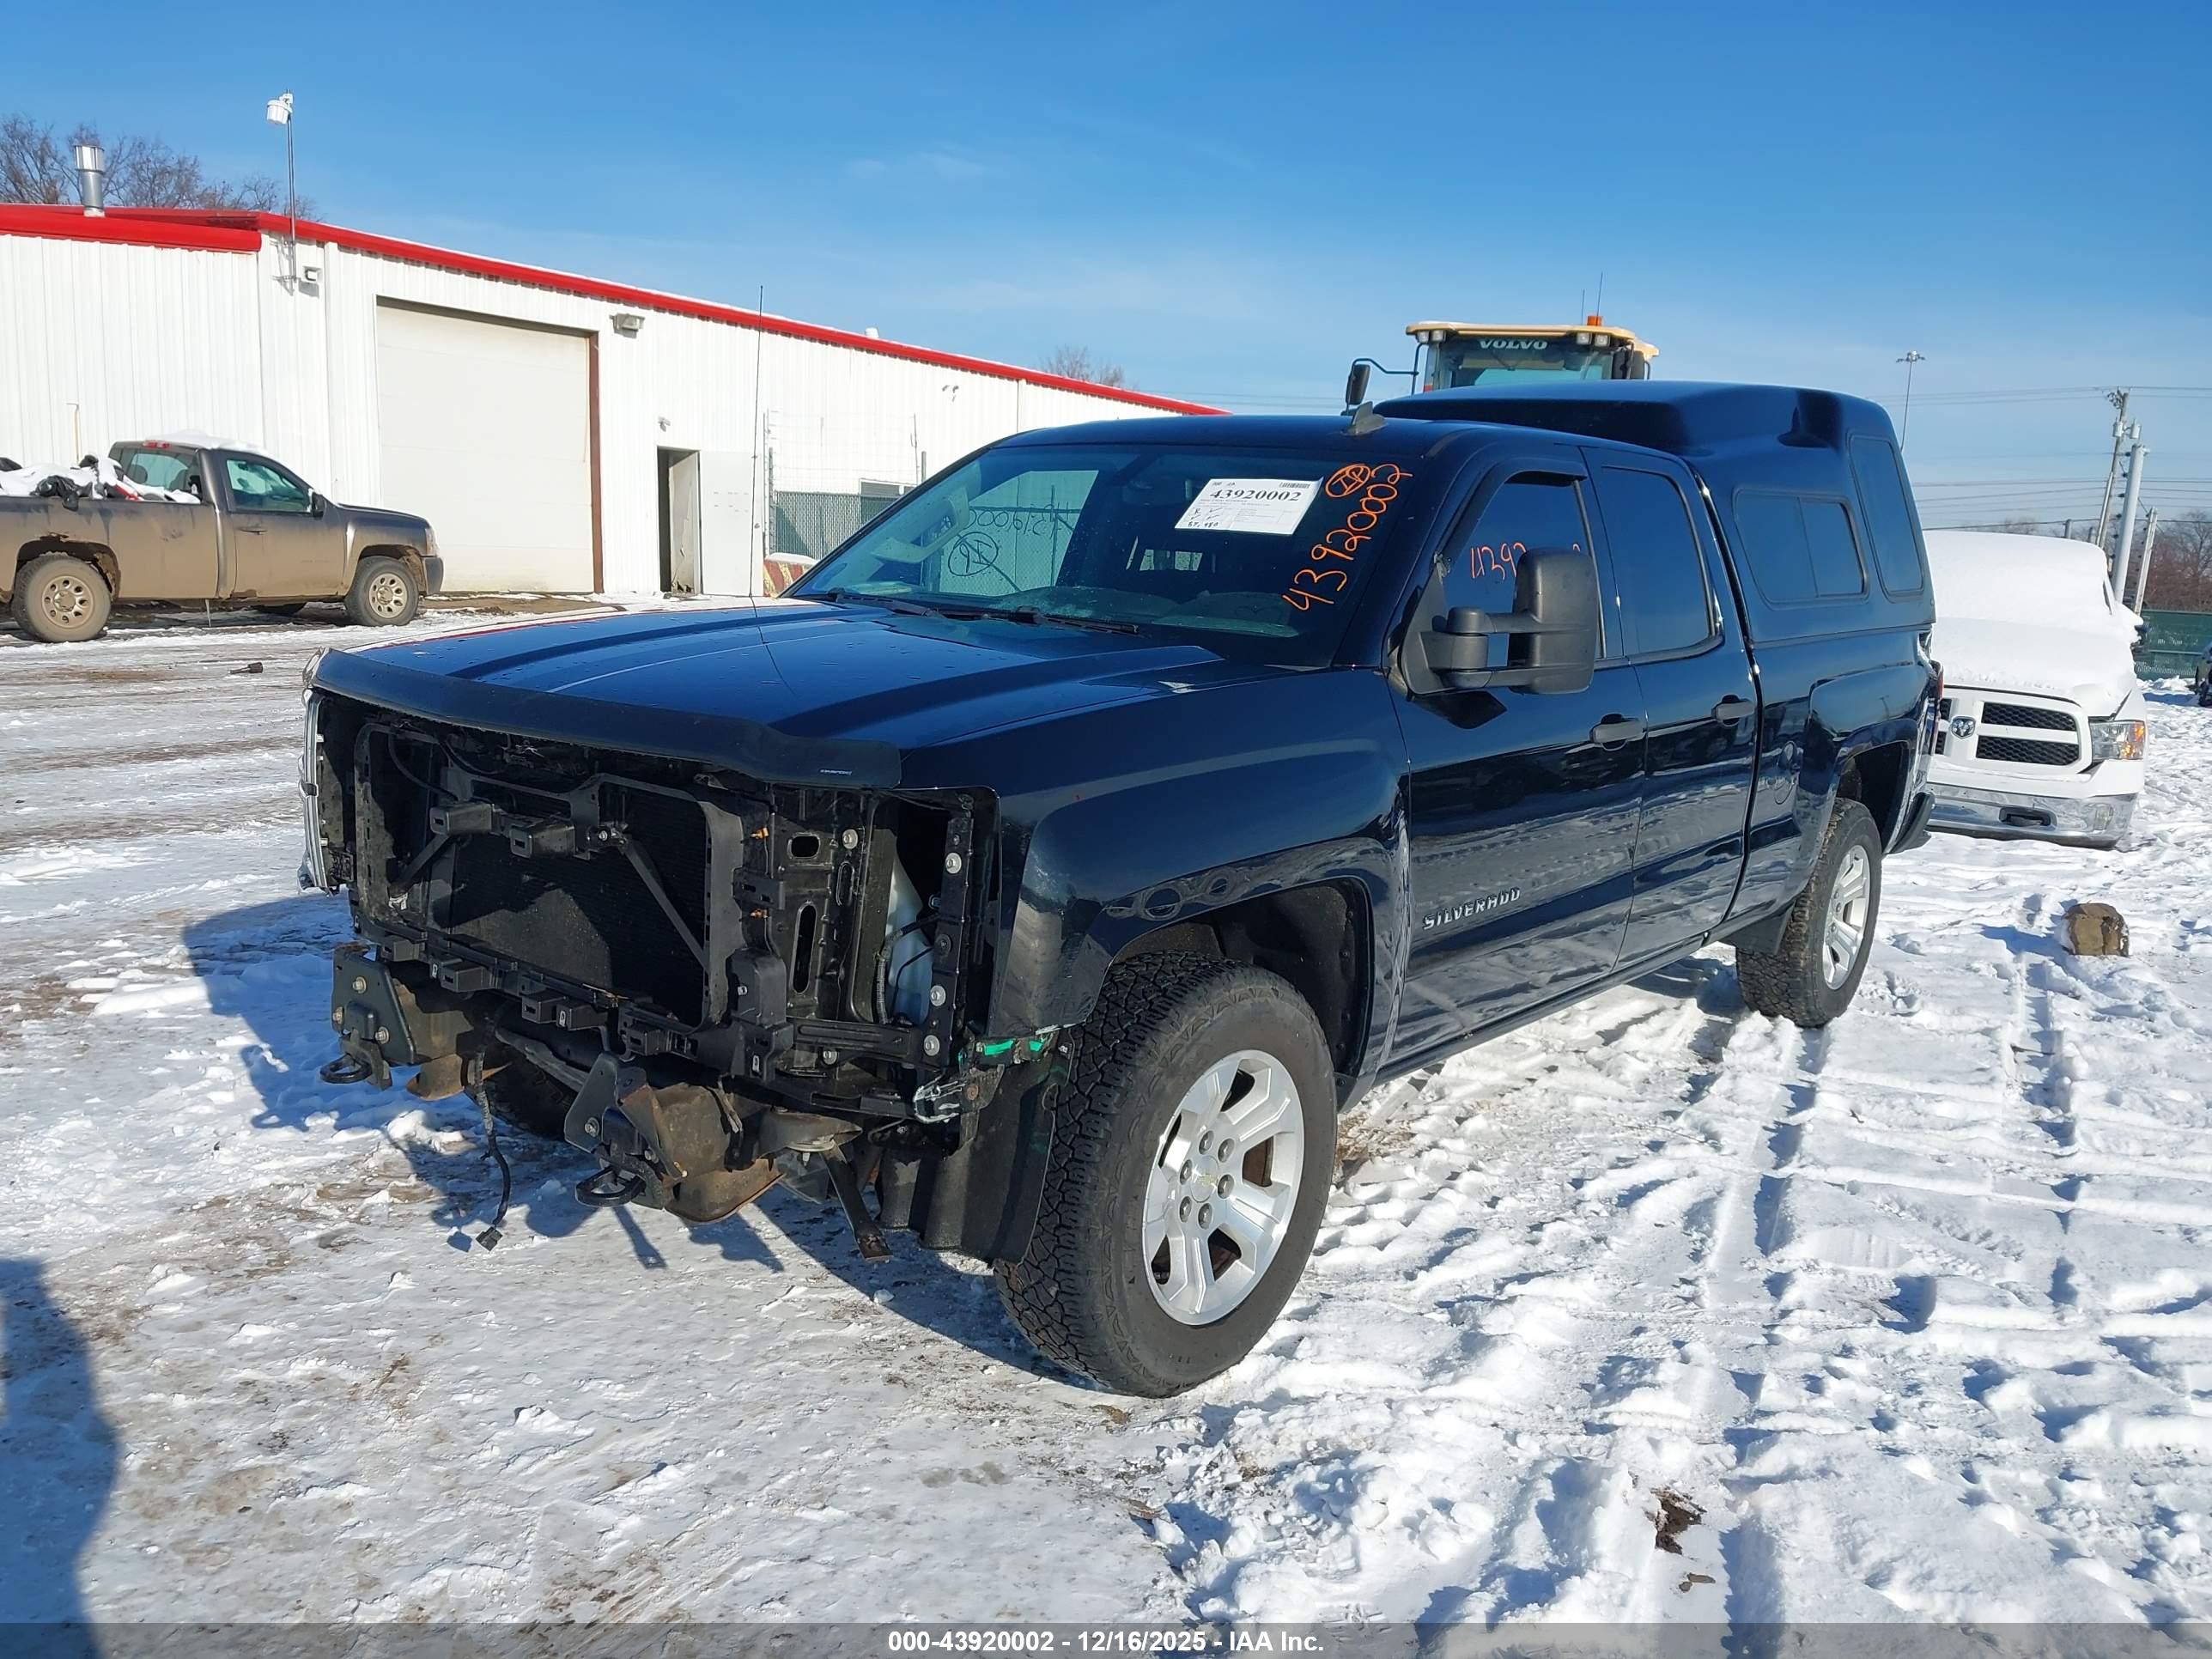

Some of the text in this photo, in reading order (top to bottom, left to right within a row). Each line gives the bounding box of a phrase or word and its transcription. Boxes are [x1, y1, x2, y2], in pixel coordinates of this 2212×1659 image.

[1480, 339, 1548, 350] VOLVO
[1209, 489, 1303, 502] 43920002
[1280, 463, 1413, 612] 43920002
[1422, 887, 1522, 931] SILVERADO
